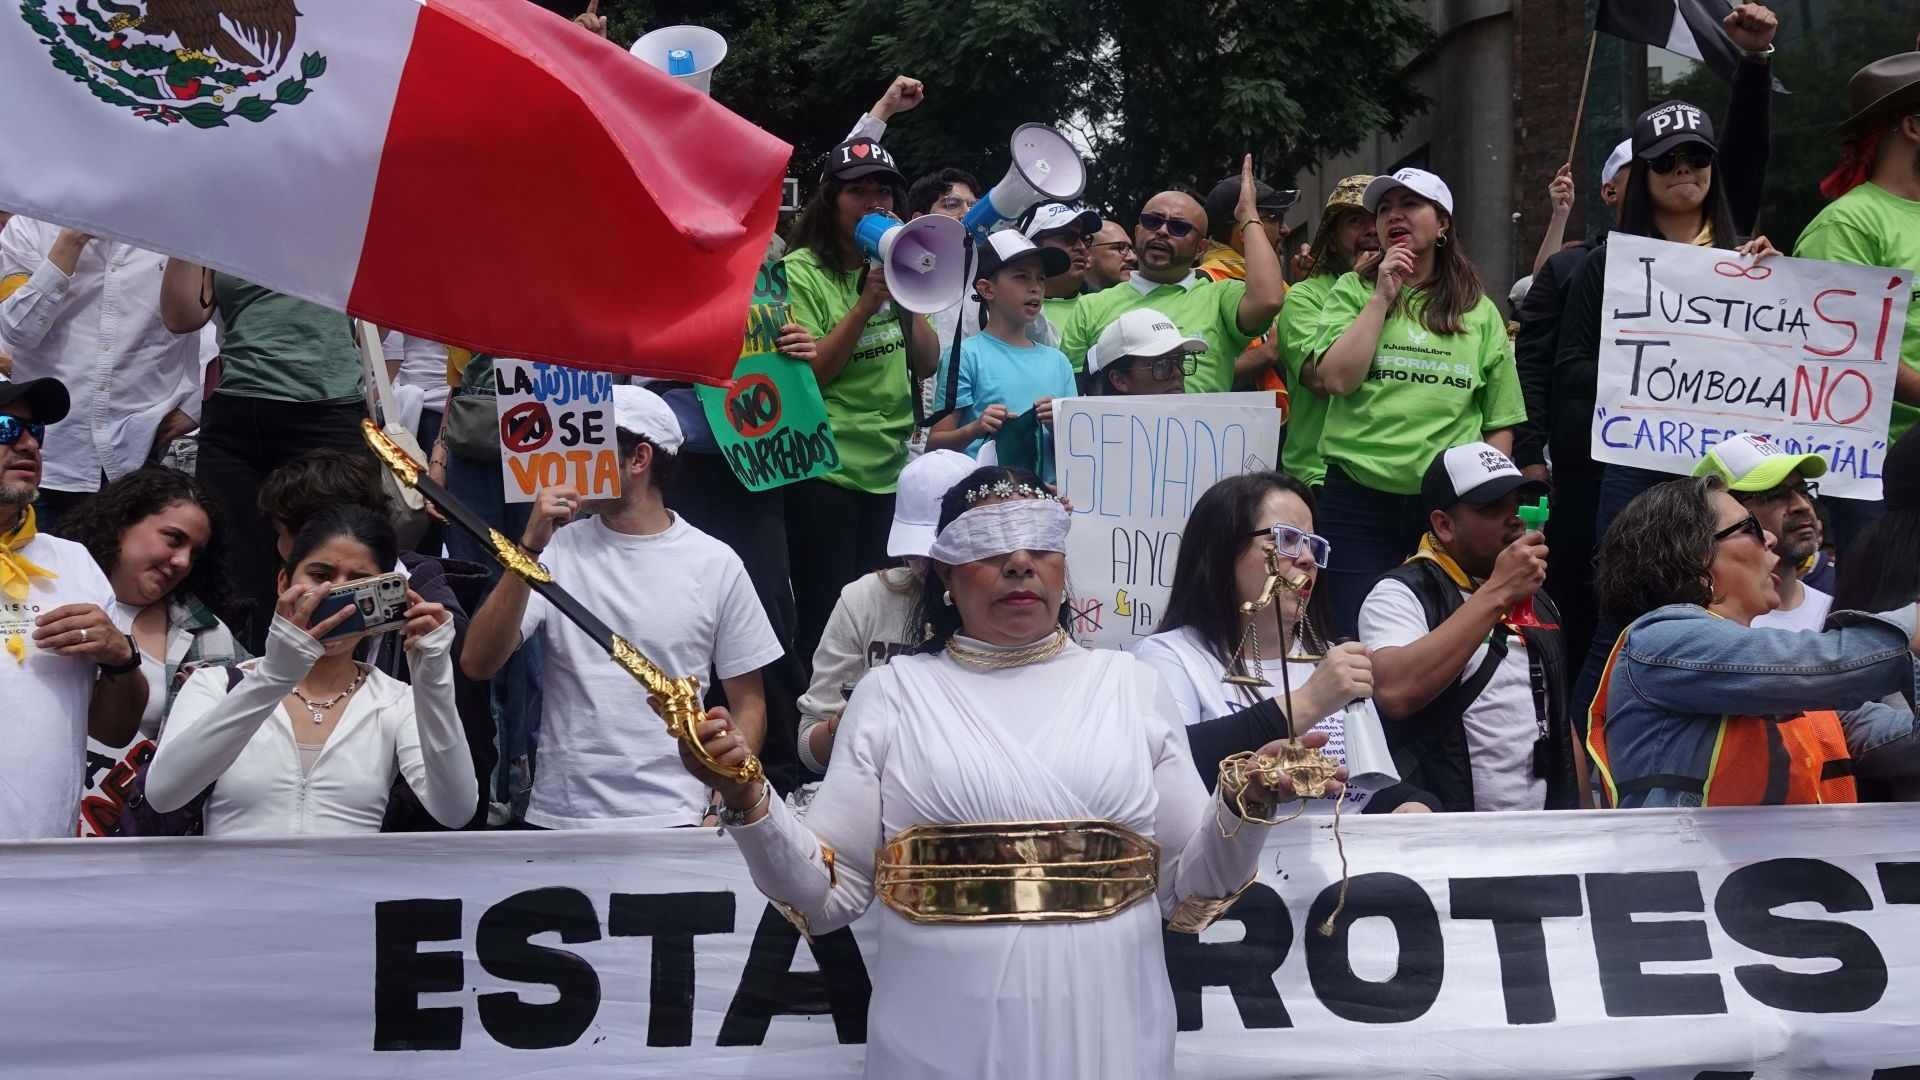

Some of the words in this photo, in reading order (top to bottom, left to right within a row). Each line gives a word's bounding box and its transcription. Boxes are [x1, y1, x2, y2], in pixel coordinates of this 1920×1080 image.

[1653, 111, 1701, 136] PJF
[841, 146, 852, 164] I
[1802, 275, 1903, 361] SÍ
[496, 366, 534, 395] LA
[1375, 355, 1450, 372] EFORMA
[1410, 372, 1439, 385] NO
[1614, 339, 1787, 412] TÓMBOLA
[1790, 364, 1873, 424] NO
[731, 383, 779, 432] NO
[558, 410, 606, 447] SE
[507, 449, 622, 497] VOTA
[373, 885, 873, 1052] ESTA
[1161, 857, 1920, 1031] ROTES
